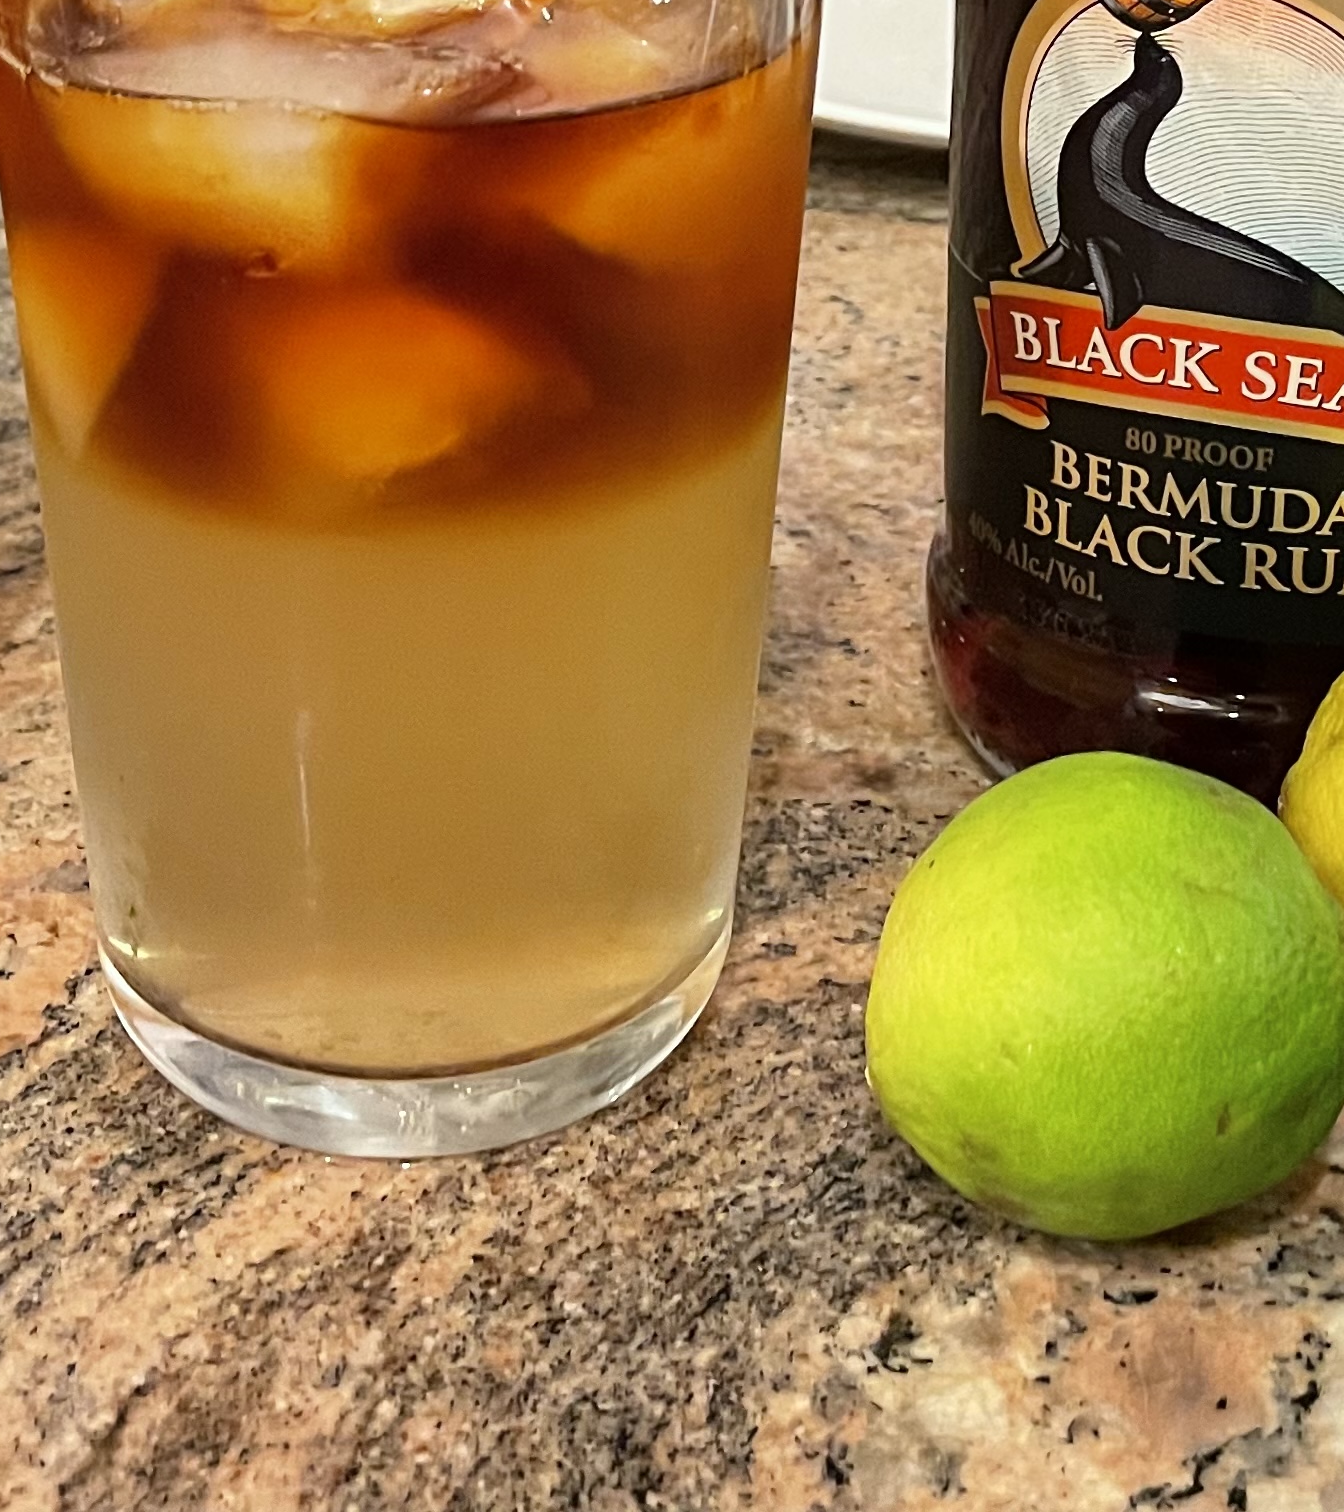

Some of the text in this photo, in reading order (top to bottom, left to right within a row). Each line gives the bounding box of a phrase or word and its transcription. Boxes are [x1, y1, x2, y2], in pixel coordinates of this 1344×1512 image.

[1009, 310, 1221, 393] BLACK
[1124, 426, 1274, 473] 80 PROOF
[1023, 483, 1225, 586] BLACK
